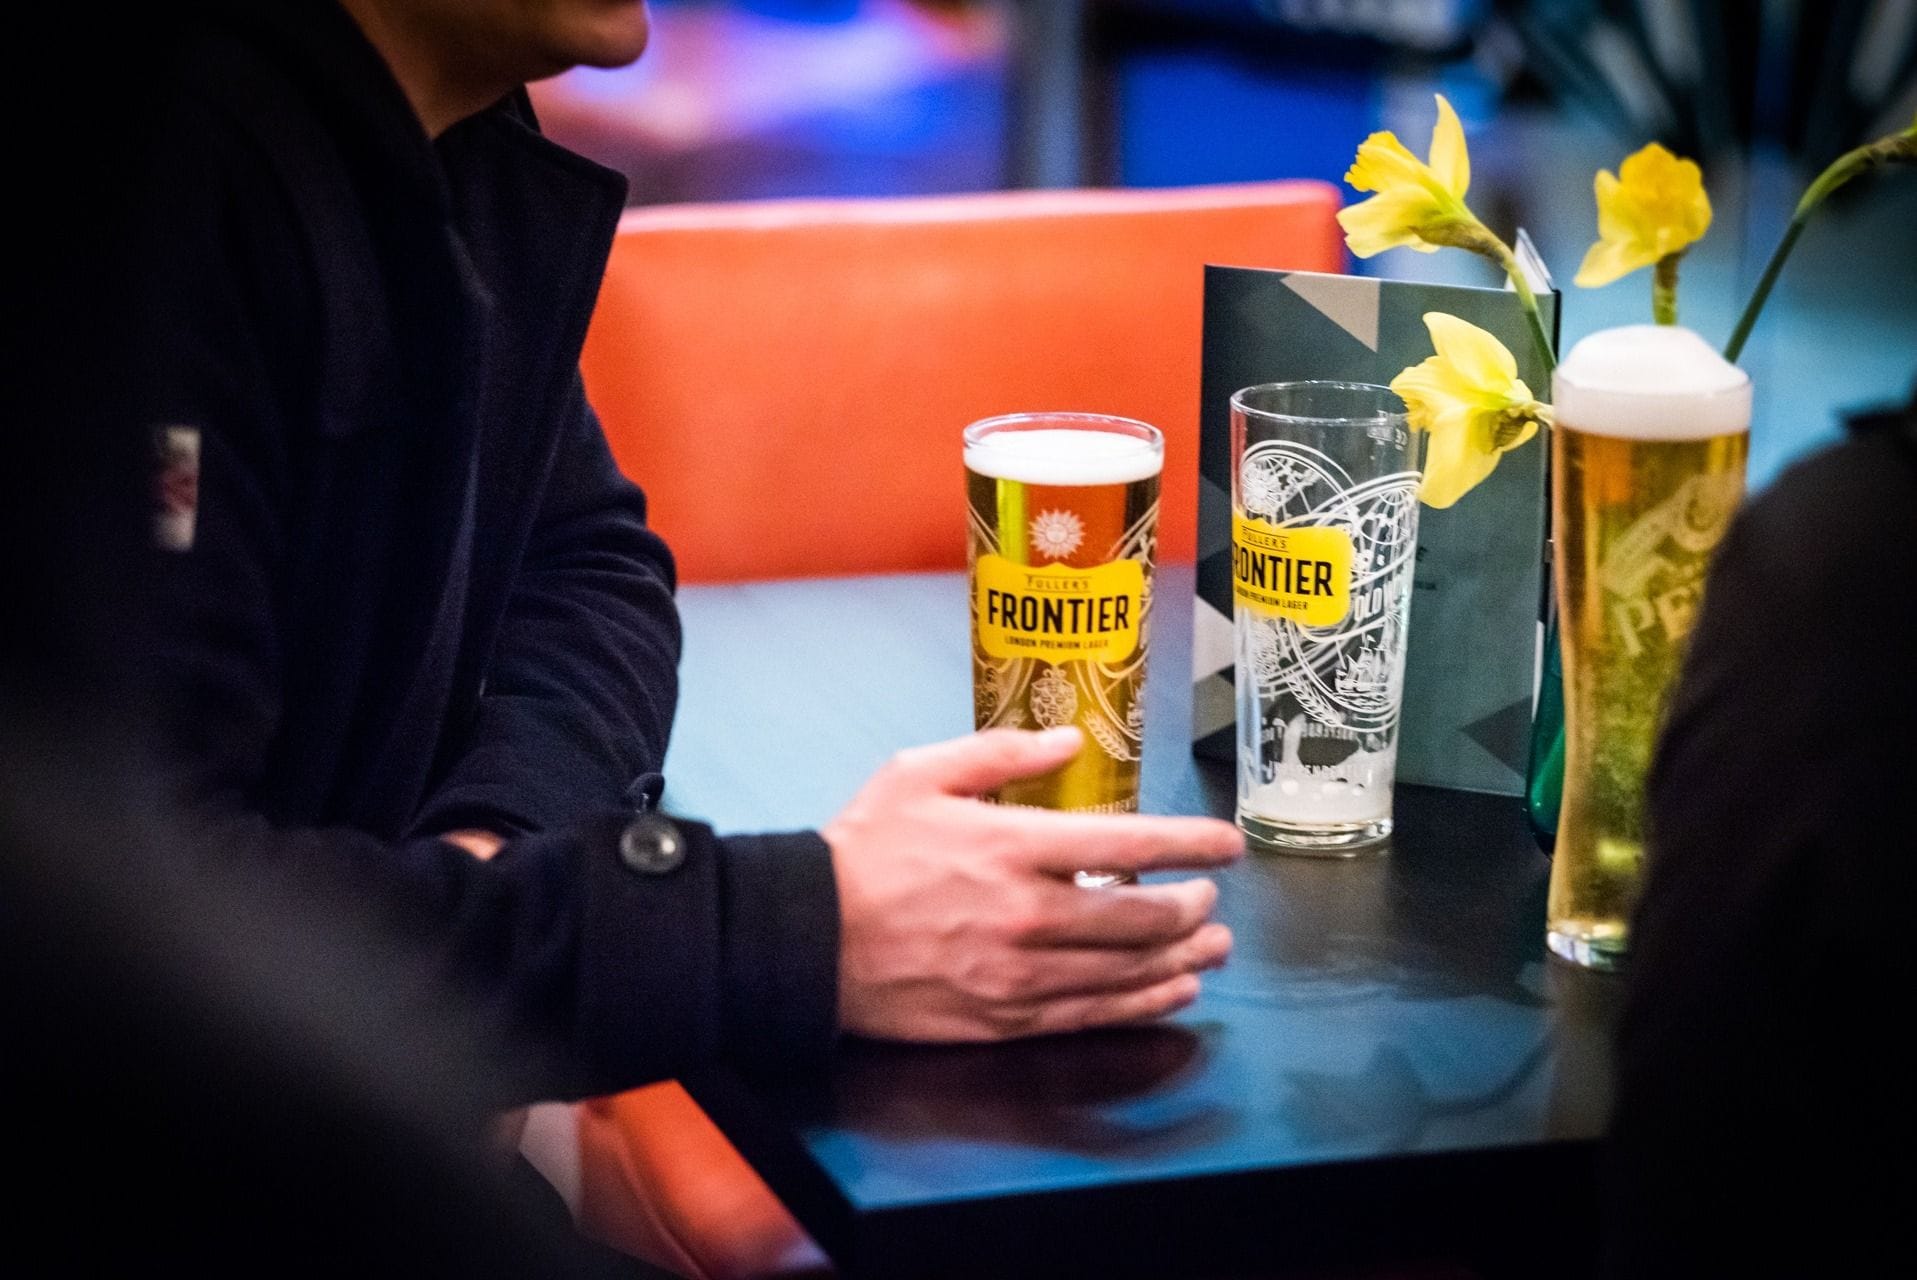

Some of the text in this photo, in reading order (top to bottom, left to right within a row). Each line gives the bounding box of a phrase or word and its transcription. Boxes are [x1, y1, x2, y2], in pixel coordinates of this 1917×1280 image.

[1233, 541, 1334, 597] RONTIER
[987, 588, 1130, 634] FRONTIER
[1282, 599, 1309, 611] LAGER
[1004, 636, 1109, 650] LONDON PREMIUM LAGER
